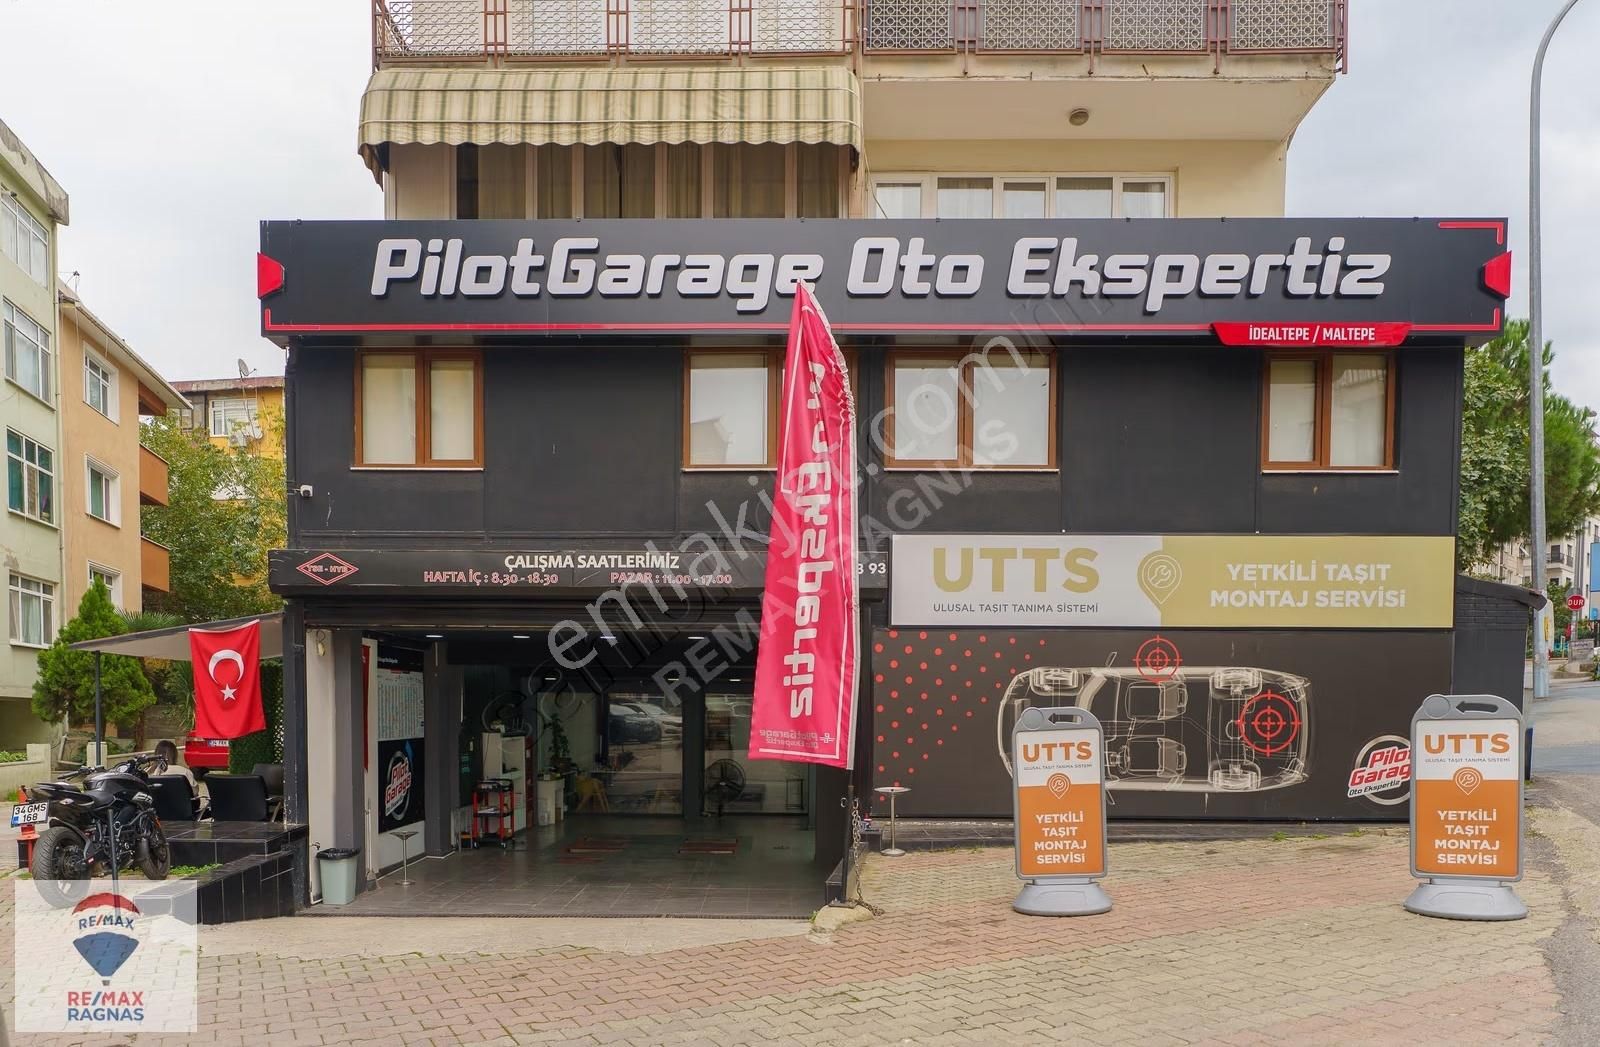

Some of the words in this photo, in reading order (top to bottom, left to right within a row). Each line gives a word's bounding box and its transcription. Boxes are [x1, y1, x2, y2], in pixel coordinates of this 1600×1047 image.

[371, 237, 824, 312] PilotGarage
[846, 236, 985, 296] Oto
[1006, 236, 1392, 312] Ekspertiz
[1249, 325, 1310, 341] İDEALTEPE
[1312, 325, 1321, 344] /
[1322, 327, 1376, 341] MALTEPE
[504, 554, 574, 572] ÇALIŞMA
[577, 552, 680, 569] SAATLERİMİZ
[868, 562, 886, 575] 93
[933, 547, 1100, 593] UTTS
[1227, 560, 1316, 581] YETKİLİ
[1324, 563, 1391, 584] TAŞIT
[423, 571, 467, 583] HAFTA
[468, 568, 482, 586] İÇ
[491, 573, 518, 585] 8.30
[527, 573, 559, 586] 18.30
[610, 572, 653, 583] PAZAR
[1210, 590, 1309, 608] MONTAJ
[933, 604, 975, 613] ULUSAL
[979, 604, 1008, 614] TAŞIT
[1012, 604, 1053, 613] TANIMA
[1056, 602, 1099, 613] SİSTEMİ
[1424, 733, 1510, 754] UTTS
[1023, 741, 1092, 763] UTTS
[1369, 748, 1410, 768] Pilo
[15, 806, 26, 815] 34
[27, 803, 46, 813] GMS
[1437, 808, 1497, 821] YETKİLİ
[23, 813, 38, 822] 168
[1036, 811, 1083, 824] YETKİLİ
[1042, 827, 1078, 838] TAŞIT
[1445, 825, 1489, 837] TAŞIT
[1034, 840, 1086, 851] MONTAJ
[1434, 839, 1500, 851] MONTAJ
